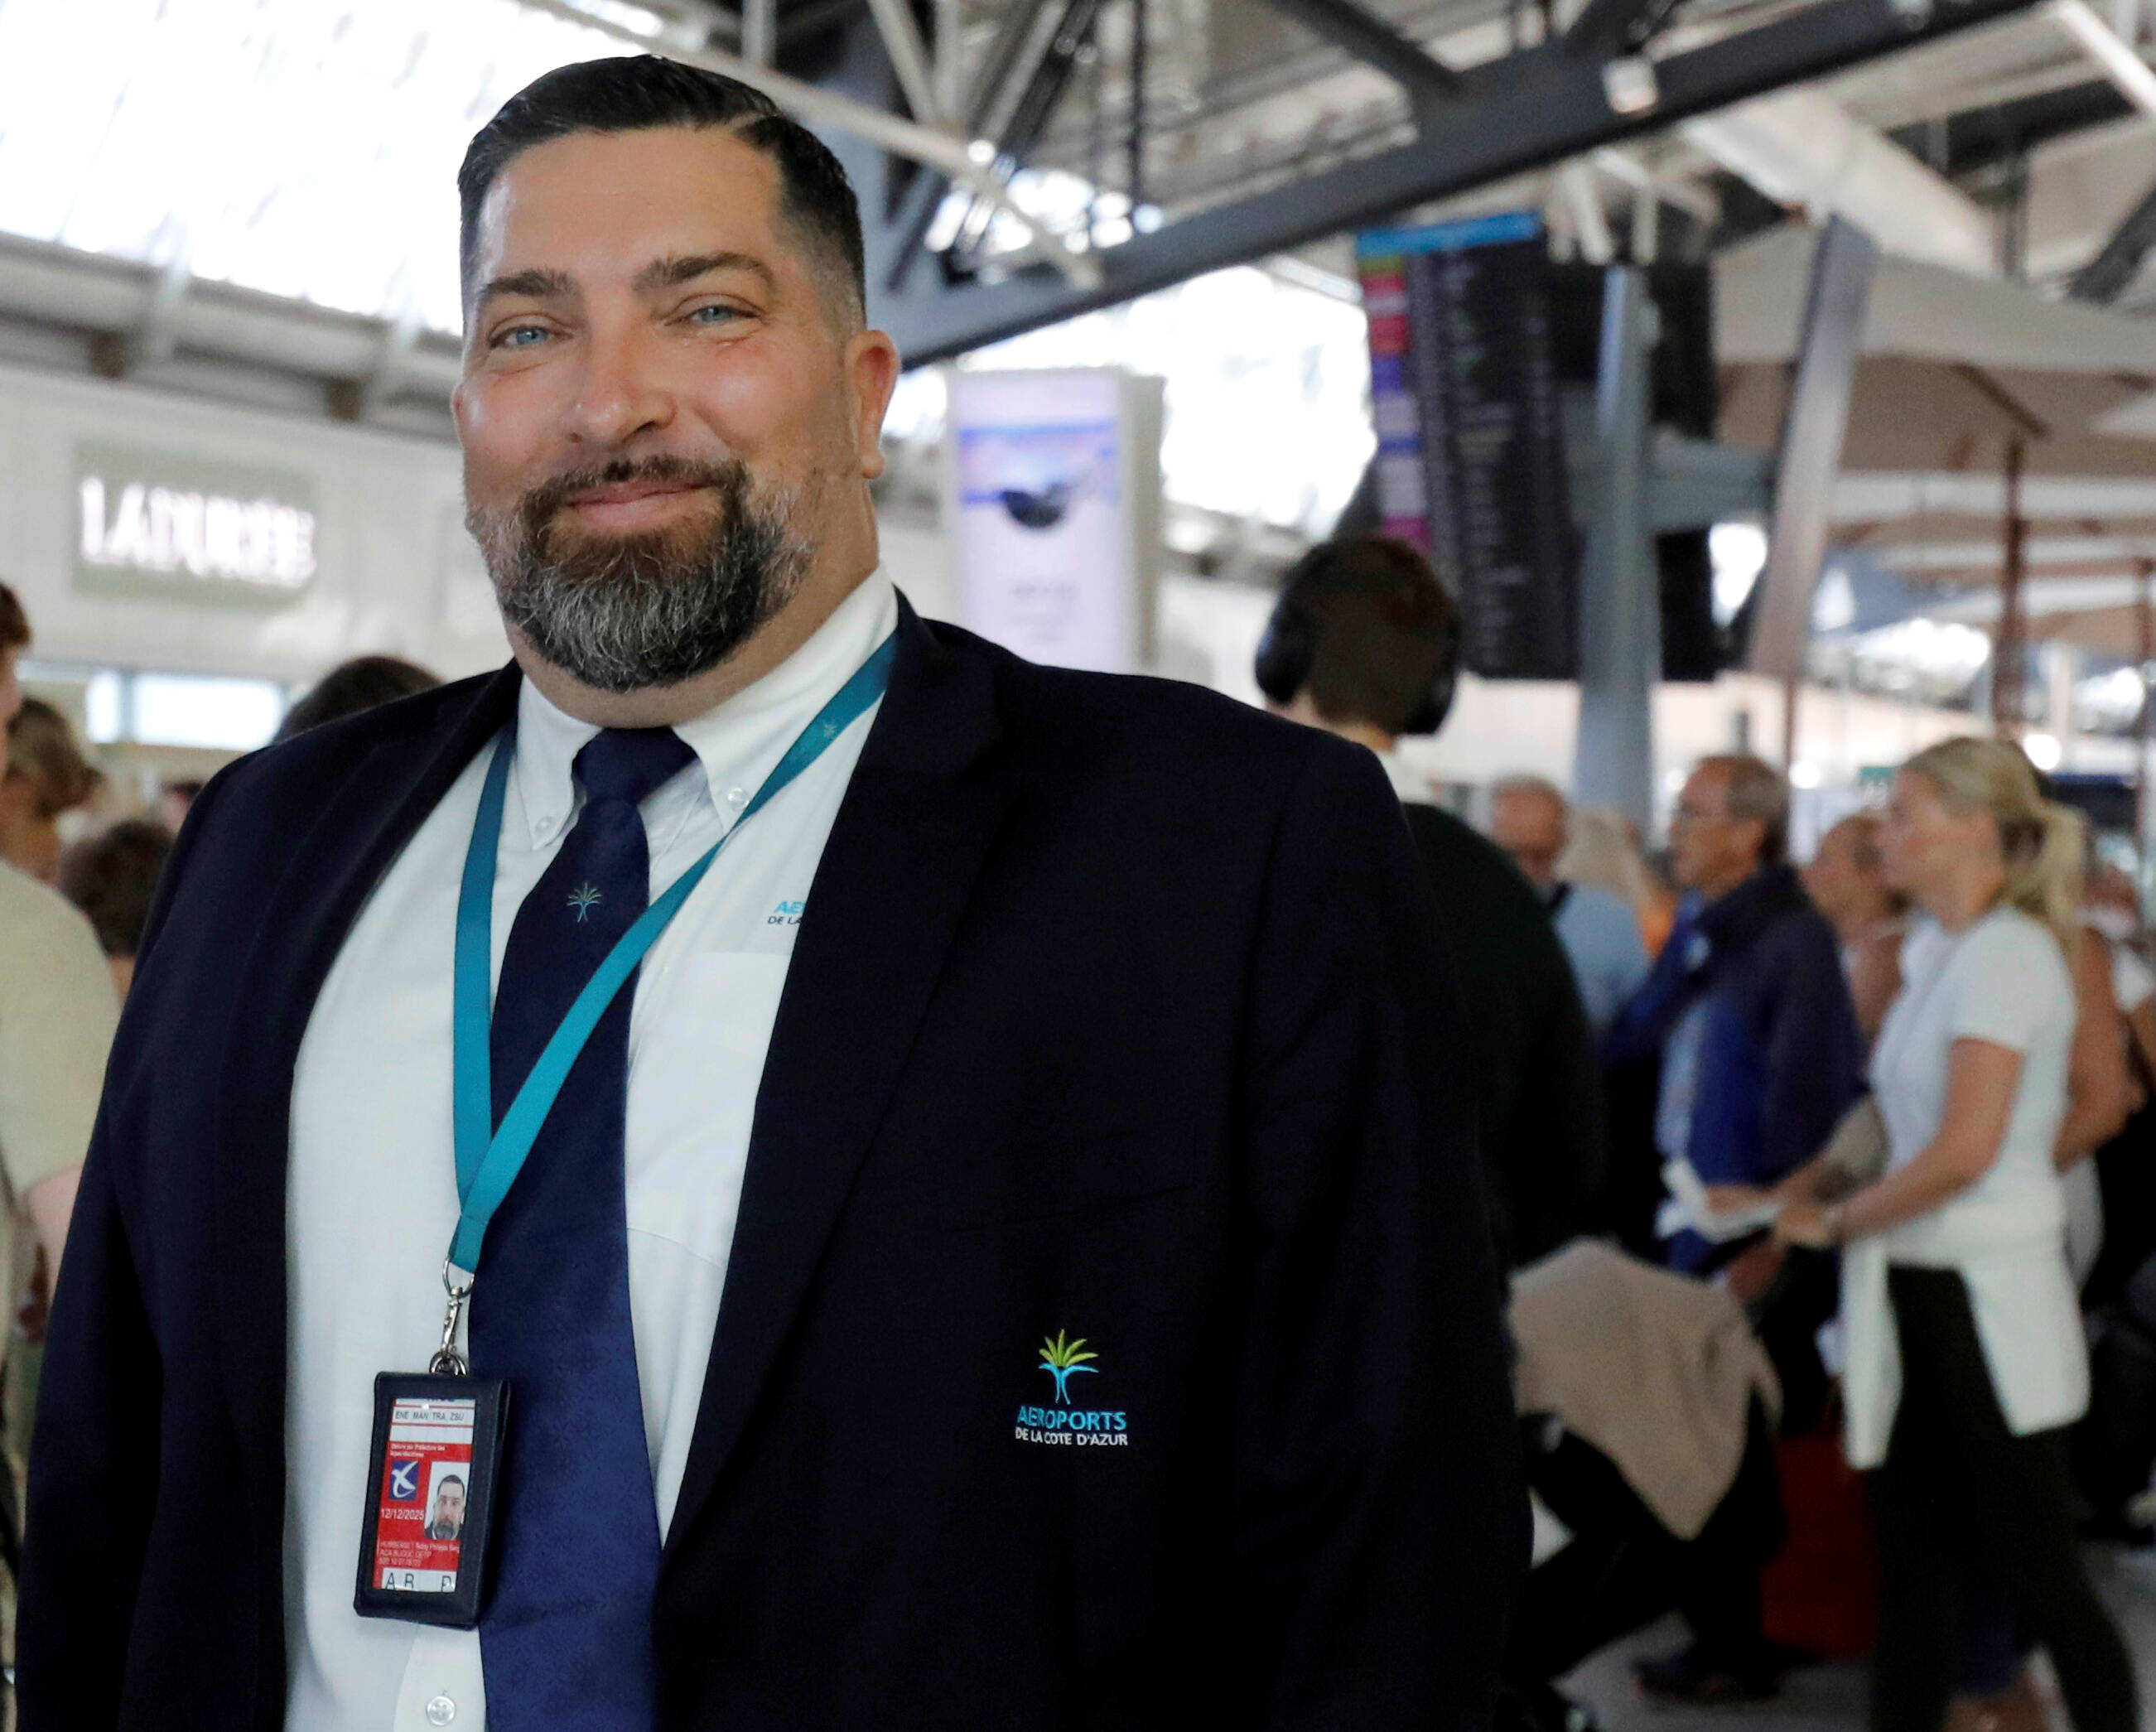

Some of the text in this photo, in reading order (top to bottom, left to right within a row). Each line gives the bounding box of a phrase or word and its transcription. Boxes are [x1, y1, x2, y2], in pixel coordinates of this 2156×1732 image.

[768, 916, 784, 925] DE
[413, 1411, 428, 1421] MAN
[432, 1412, 446, 1421] TRA
[1017, 1406, 1126, 1430] AEROPORTS
[1015, 1426, 1128, 1445] DE LA COTE D'AZUR
[380, 1508, 425, 1521] 12/12/2025
[386, 1572, 396, 1590] A
